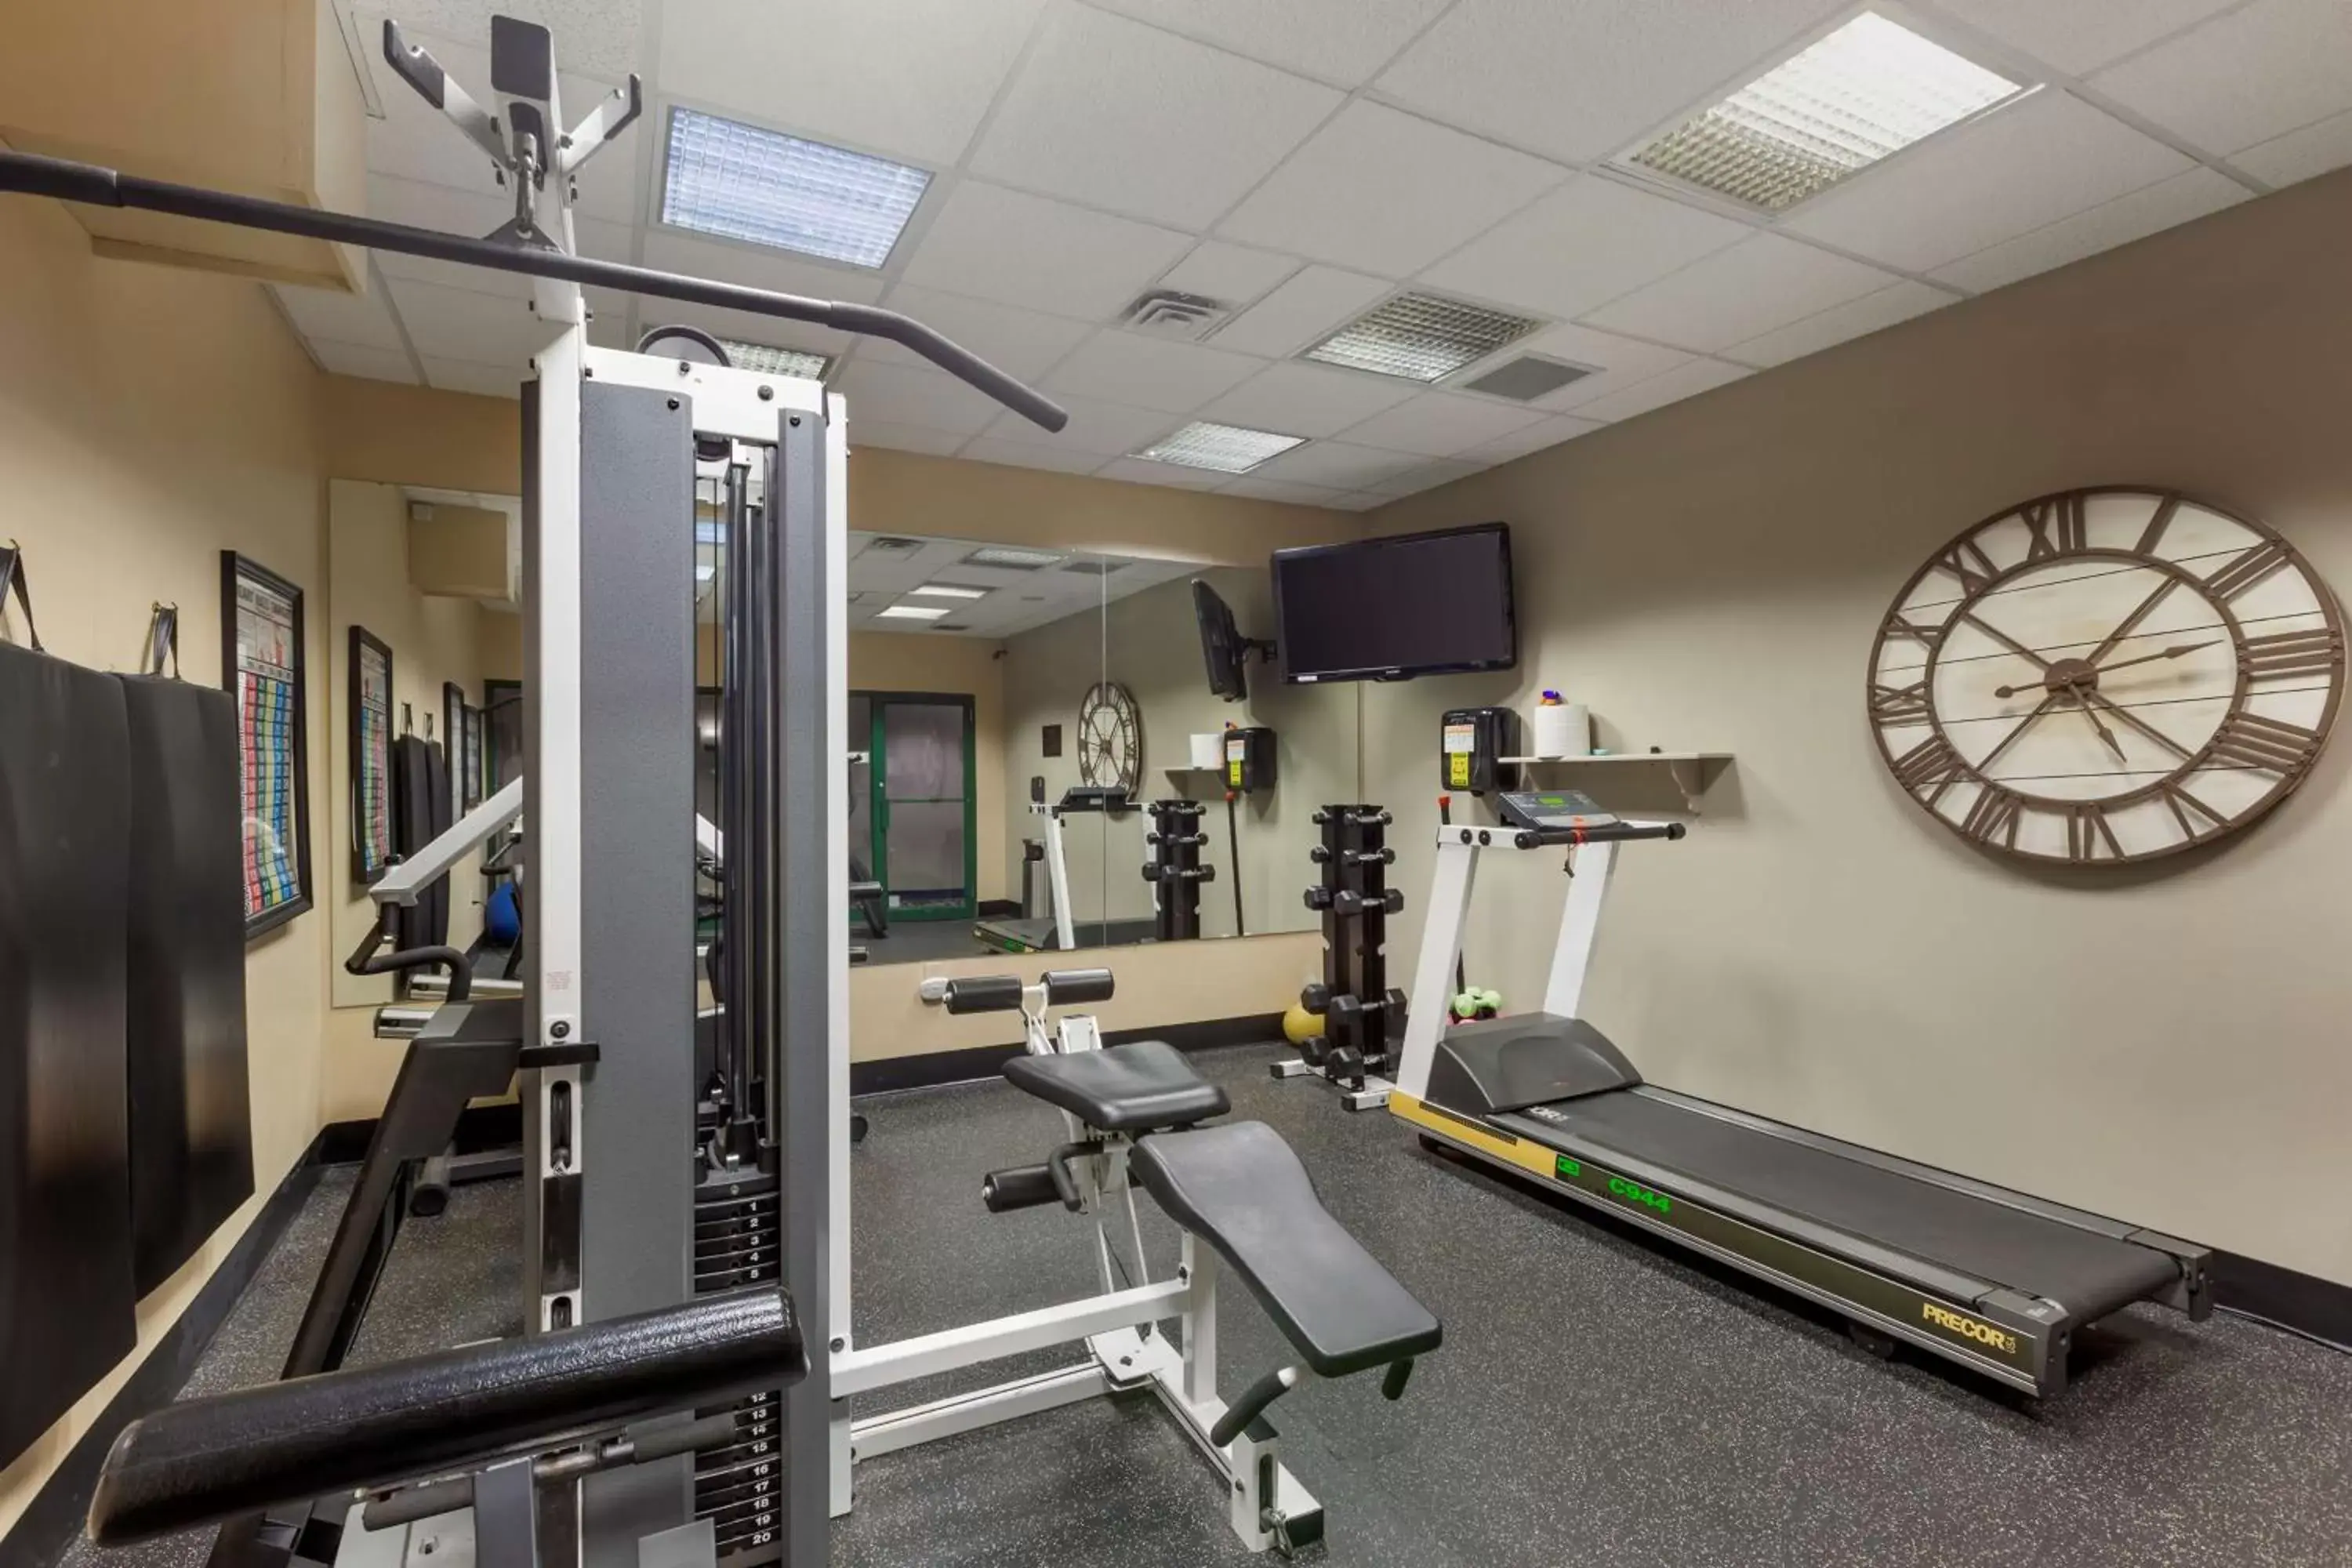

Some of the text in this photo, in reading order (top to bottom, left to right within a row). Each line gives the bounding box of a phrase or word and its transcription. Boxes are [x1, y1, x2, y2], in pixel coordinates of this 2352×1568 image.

[2019, 493, 2087, 559] XII
[2133, 492, 2182, 555] I
[1934, 540, 2001, 596] XI
[1883, 612, 1947, 647] X
[1609, 1178, 1672, 1213] C944
[750, 1202, 757, 1211] 1
[750, 1218, 759, 1228] 2
[750, 1236, 760, 1246] 3
[750, 1252, 760, 1261] 4
[1923, 1303, 2005, 1350] PRECOR
[751, 1392, 767, 1403] 12
[752, 1409, 767, 1420] 13
[752, 1424, 767, 1436] 14
[753, 1442, 768, 1454] 15
[753, 1464, 769, 1476] 16
[754, 1480, 769, 1493] 17
[753, 1498, 769, 1510] 18
[755, 1514, 771, 1526] 19
[752, 1532, 771, 1545] 20
